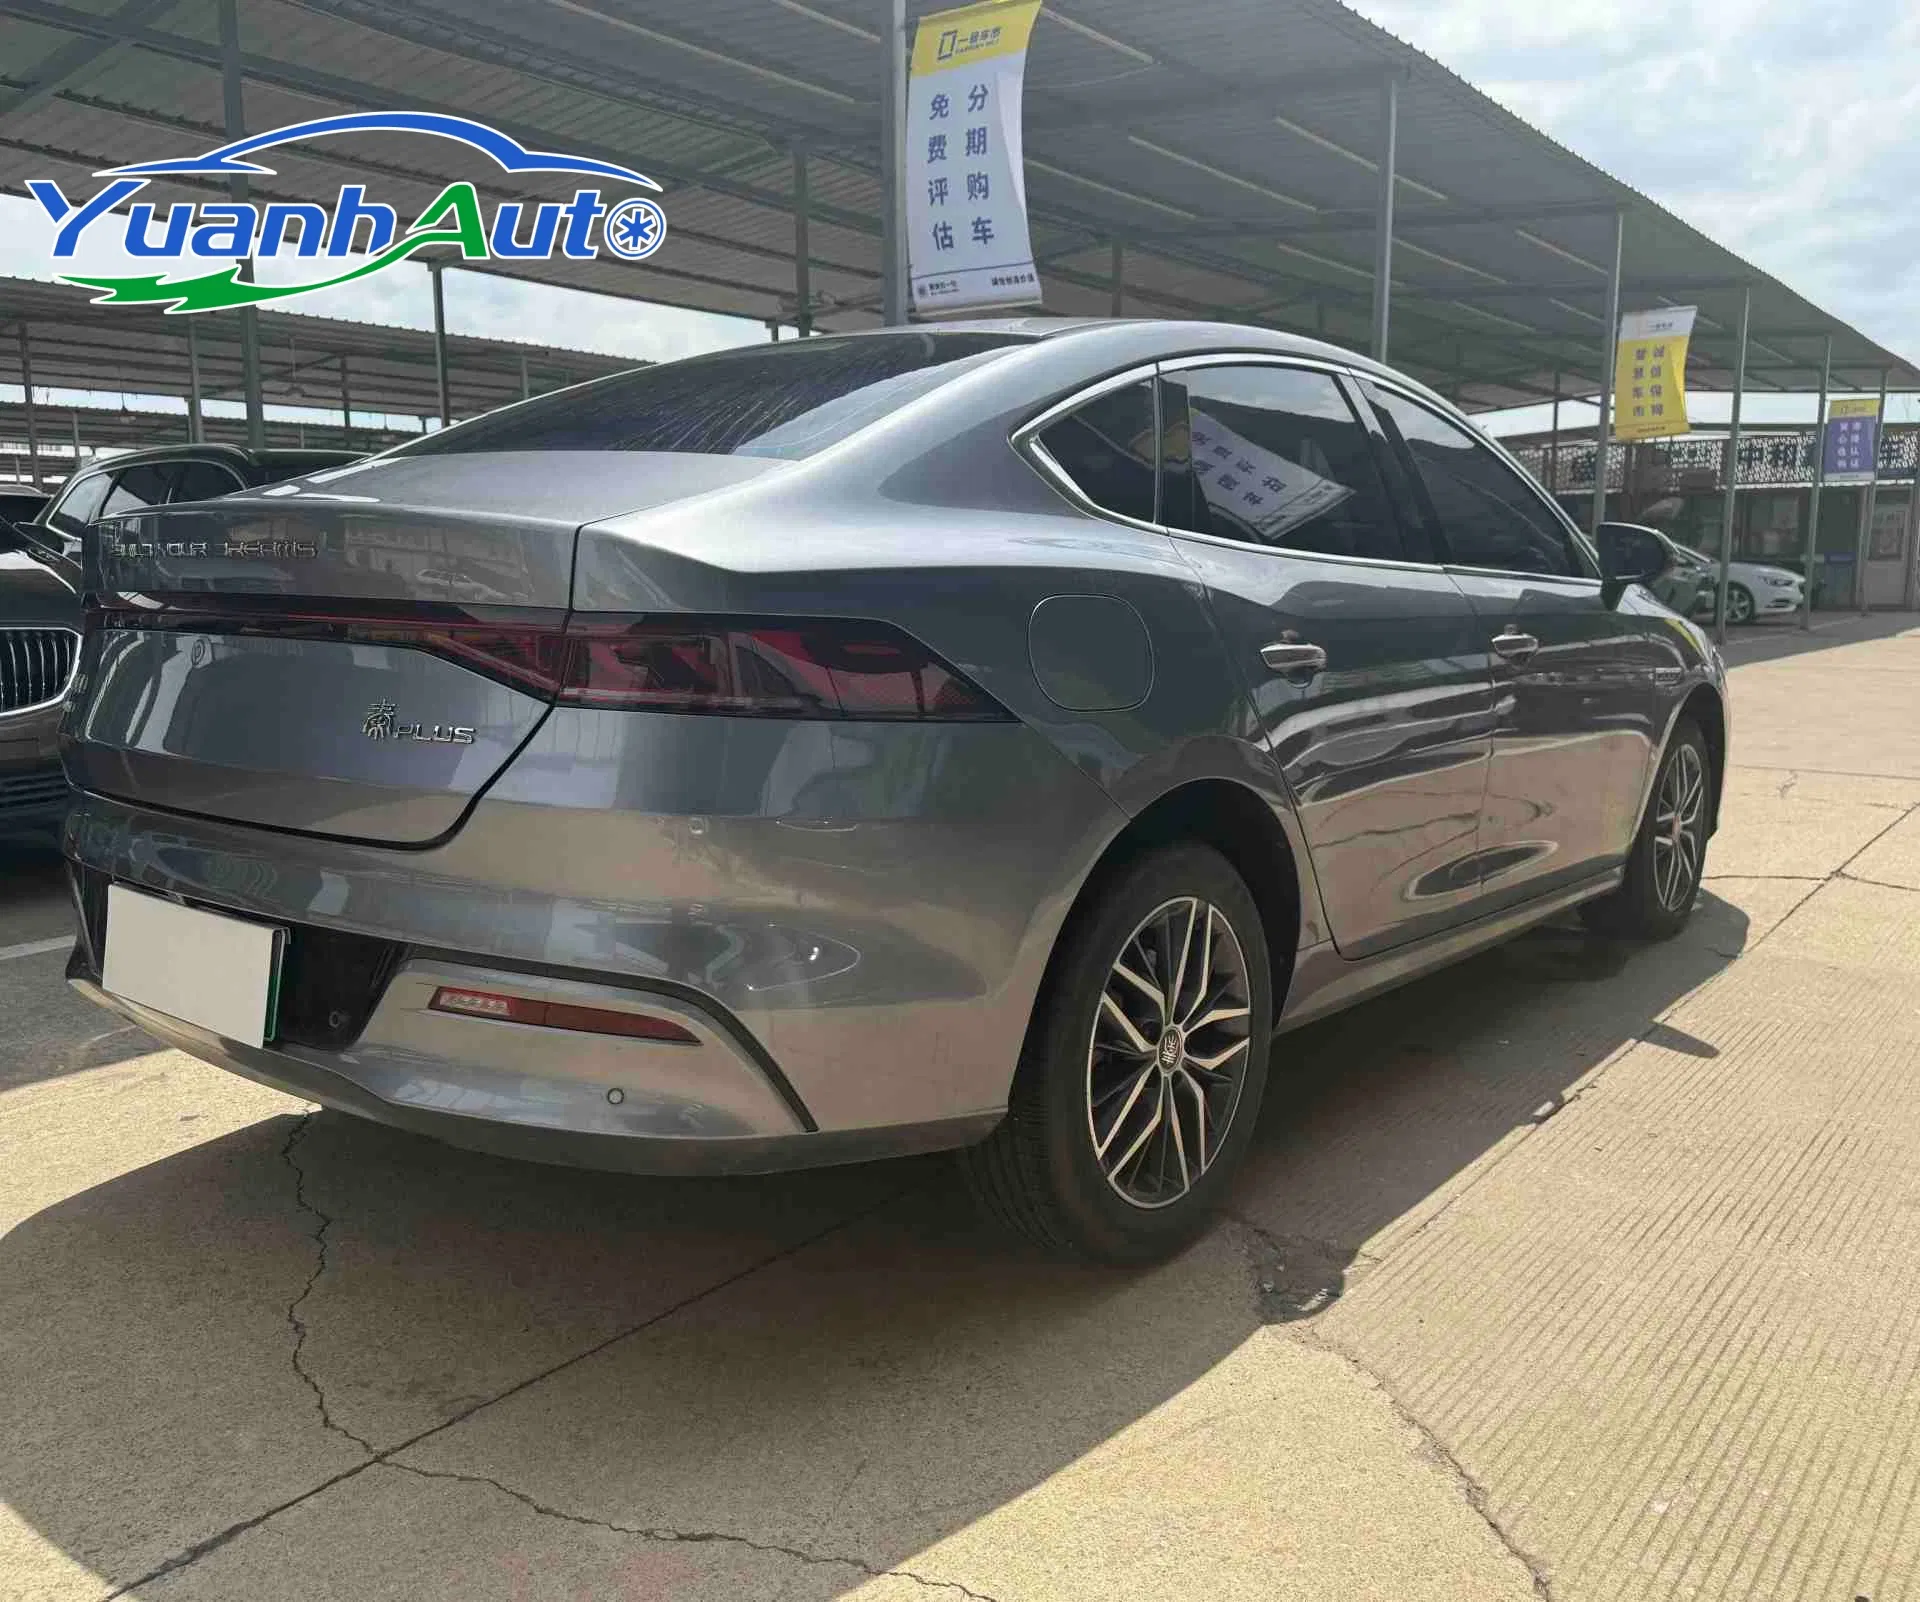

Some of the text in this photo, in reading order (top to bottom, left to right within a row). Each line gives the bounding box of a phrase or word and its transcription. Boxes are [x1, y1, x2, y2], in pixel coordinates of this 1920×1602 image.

[927, 93, 954, 251] 免费评估
[965, 83, 995, 246] 分期购车
[393, 722, 475, 744] PLUS
